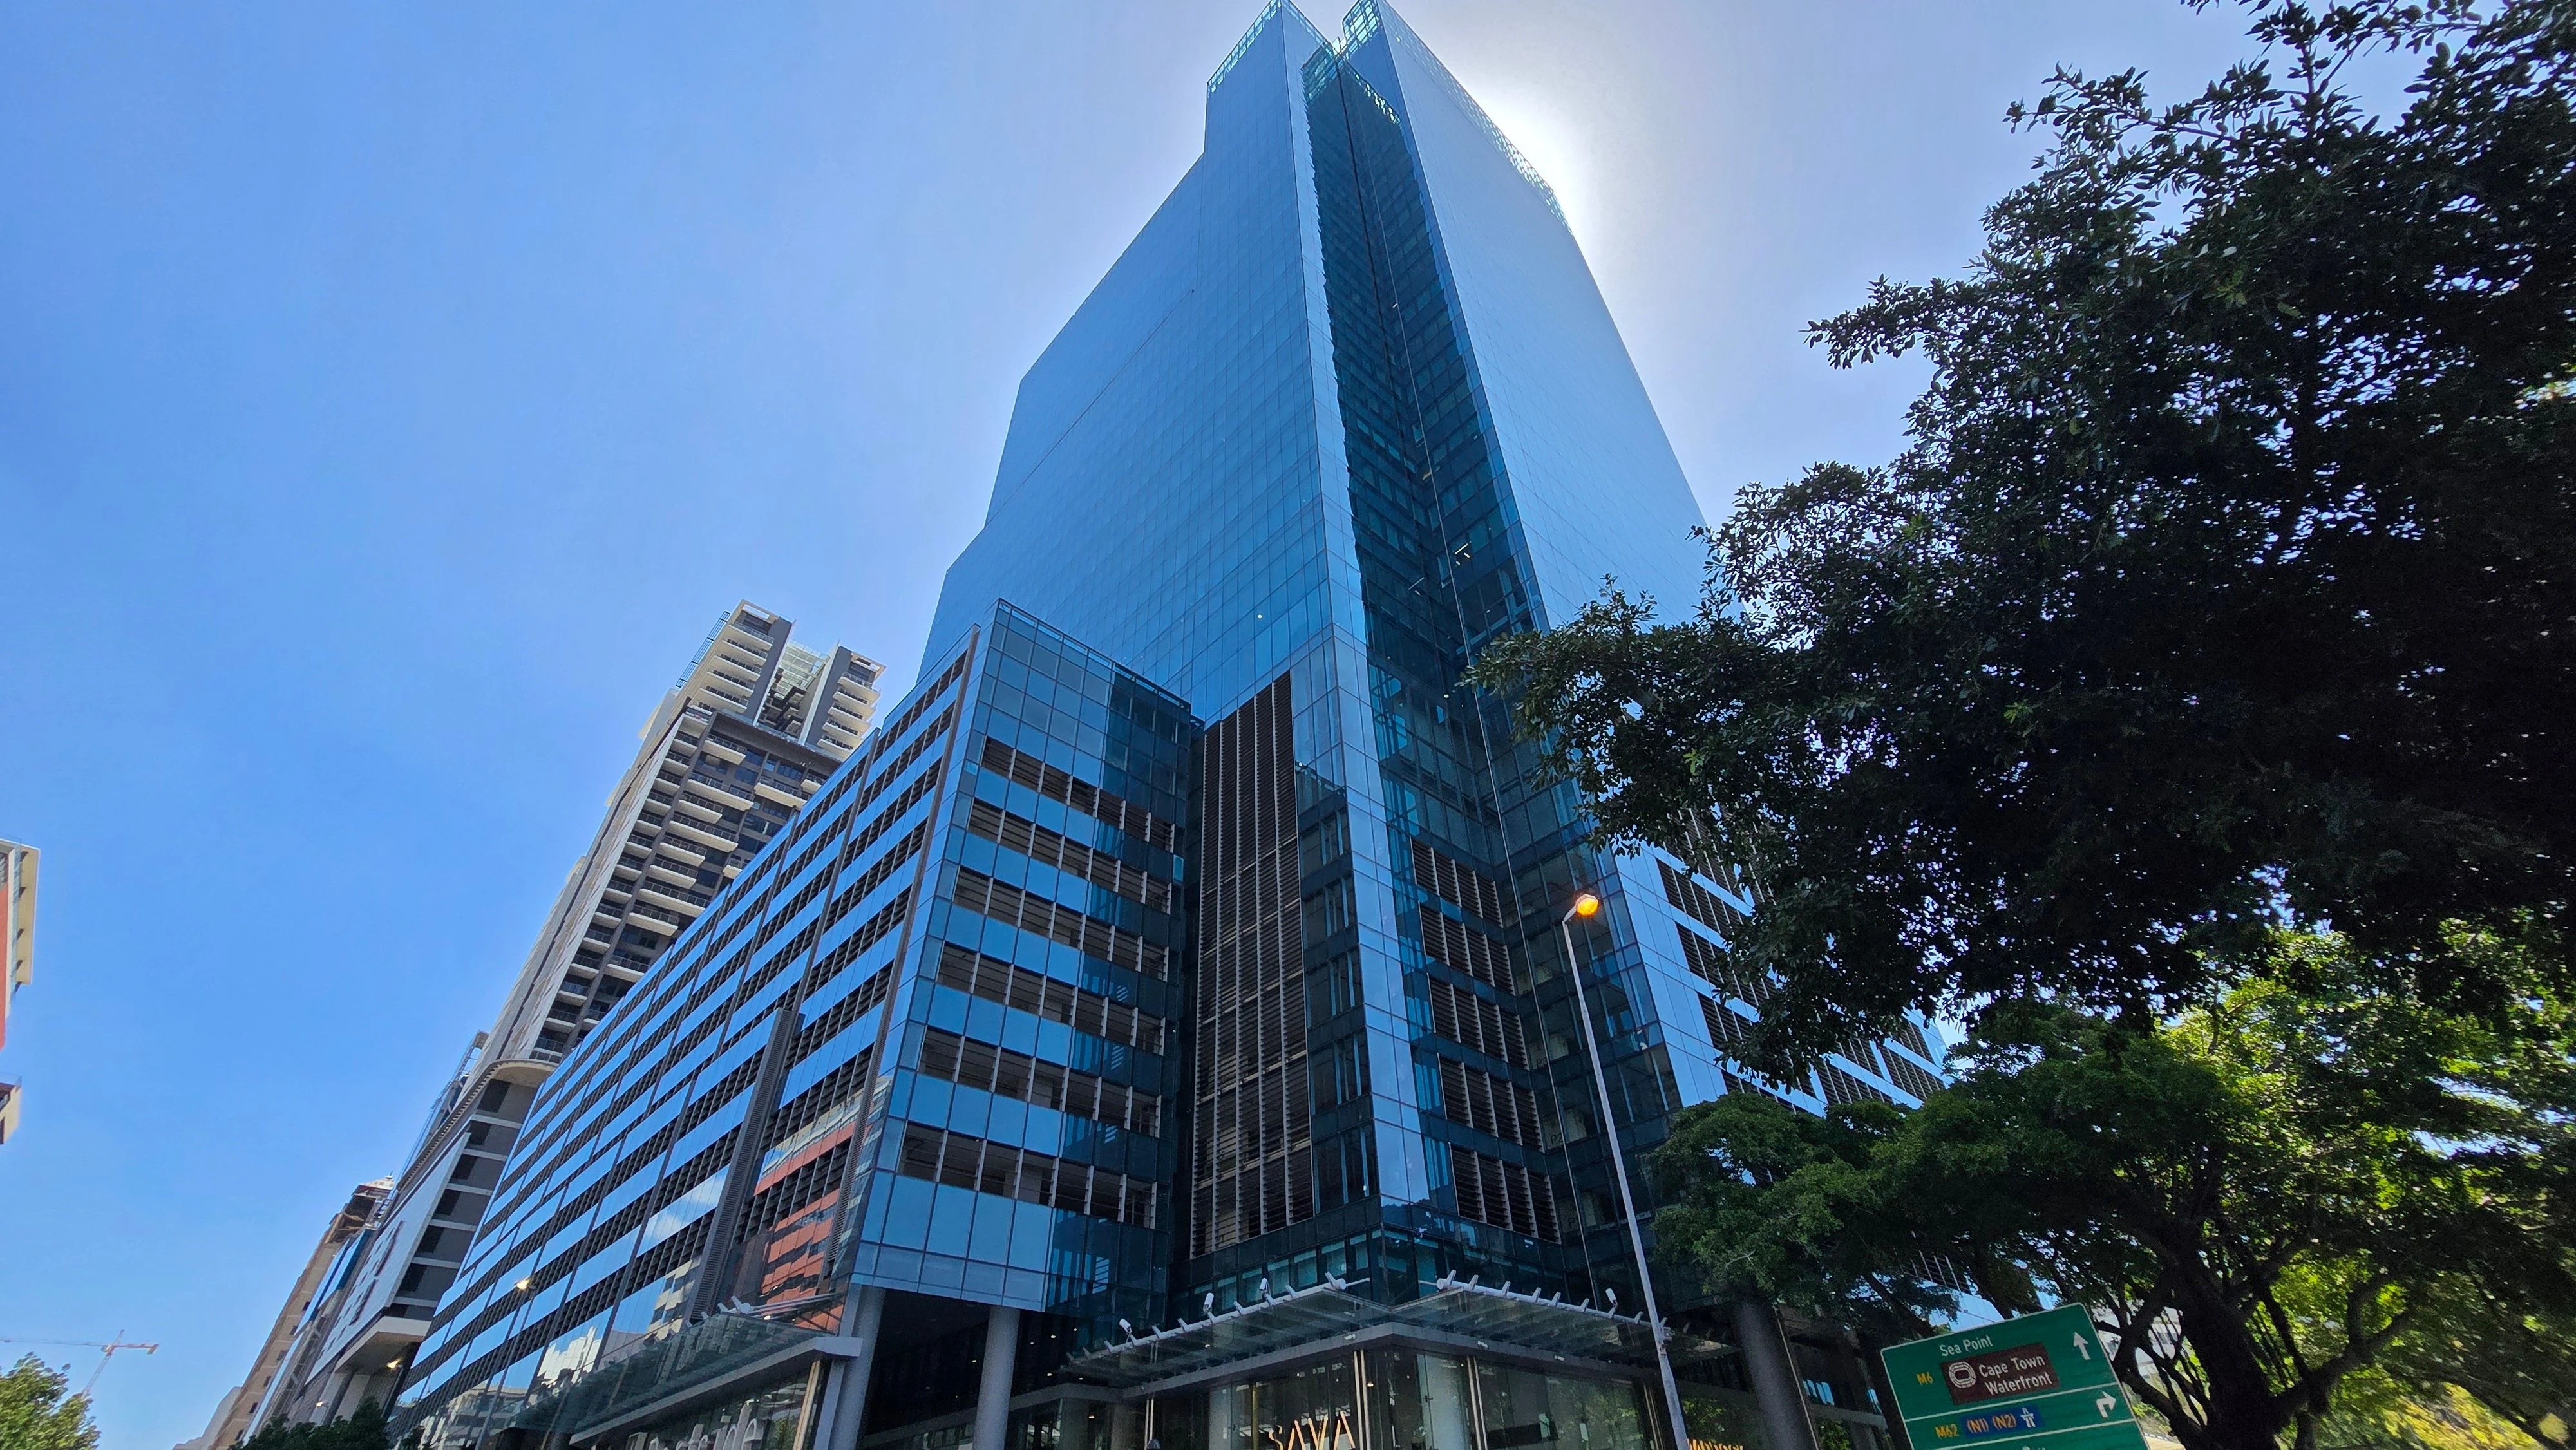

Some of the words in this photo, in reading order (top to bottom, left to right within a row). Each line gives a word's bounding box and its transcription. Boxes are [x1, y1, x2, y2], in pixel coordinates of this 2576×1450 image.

[1551, 1133, 1563, 1145] P2
[1940, 1344, 1961, 1357] Sea
[1963, 1335, 1993, 1351] Point
[1978, 1362, 2008, 1378] Cape
[2011, 1355, 2045, 1371] Town
[1916, 1372, 1933, 1385] M6
[1985, 1371, 2052, 1395] Waterfront
[1935, 1424, 1960, 1439] M62
[1966, 1418, 1989, 1433] (N1)
[1992, 1413, 2017, 1430] (N2)
